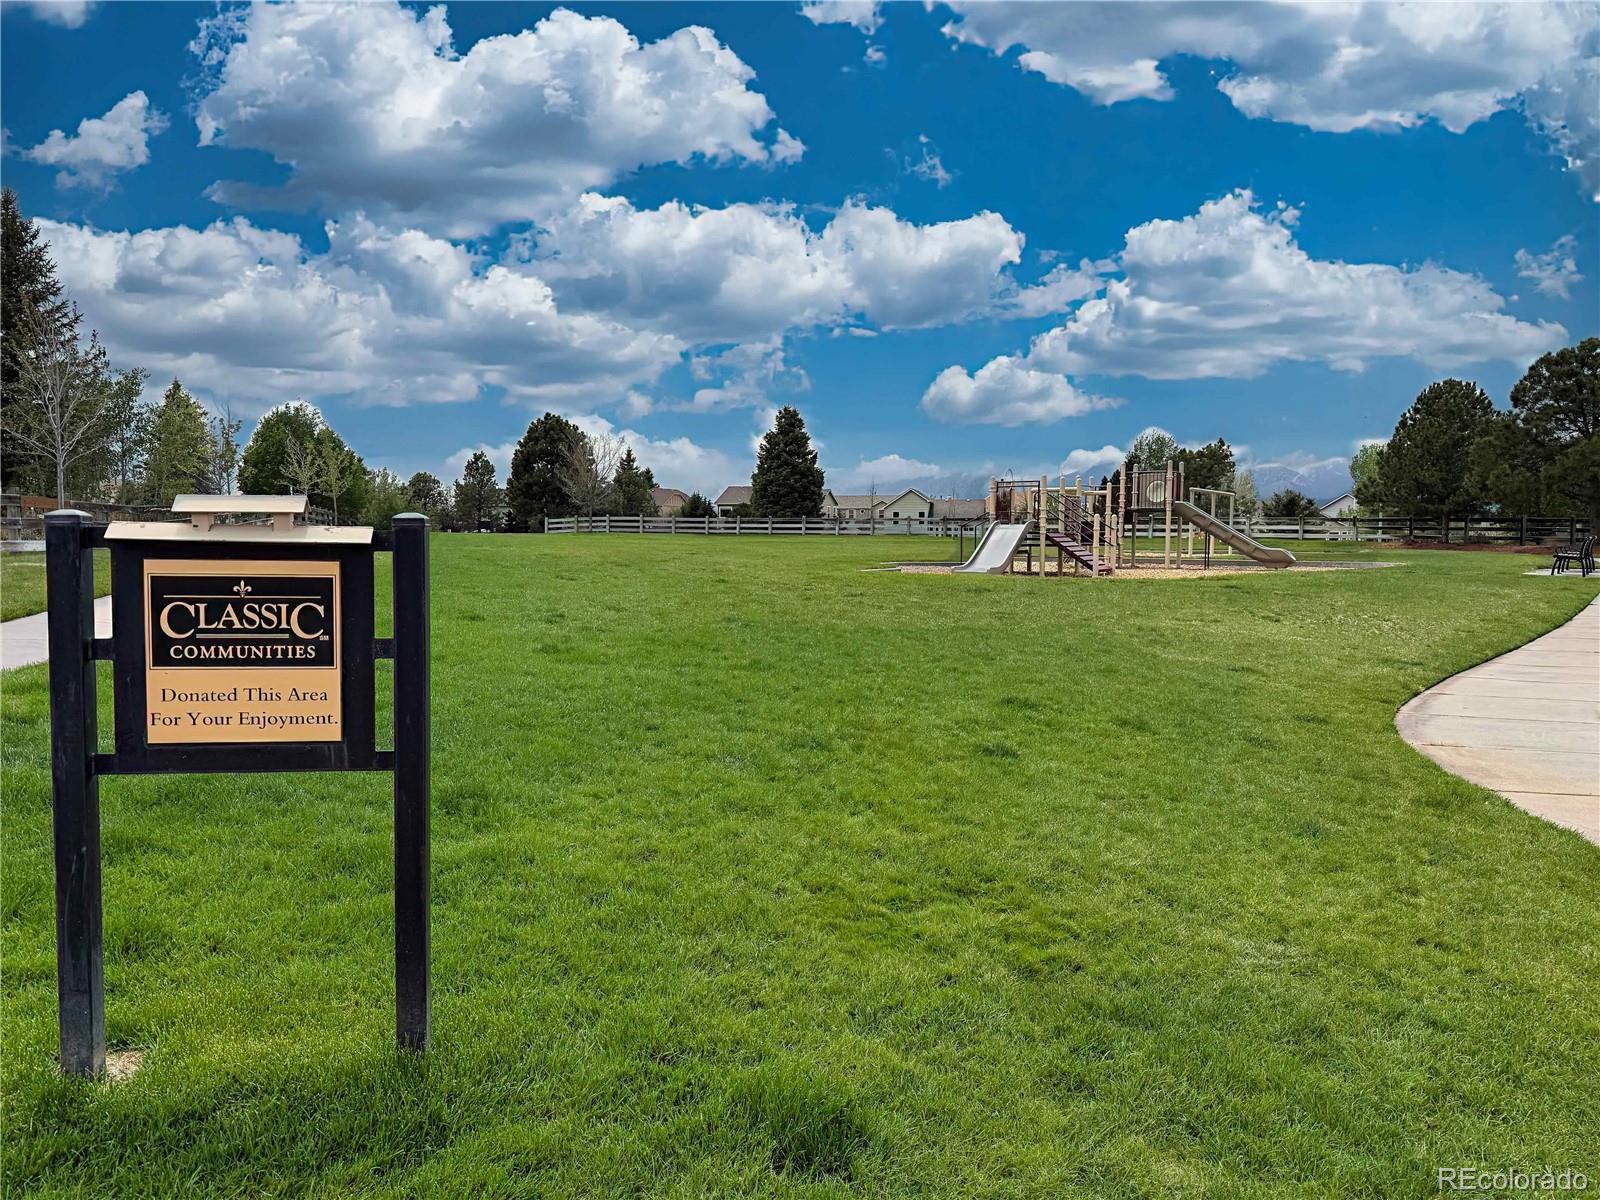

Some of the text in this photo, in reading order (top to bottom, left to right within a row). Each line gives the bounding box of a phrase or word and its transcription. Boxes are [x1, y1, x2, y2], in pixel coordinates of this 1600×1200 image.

[160, 601, 325, 640] CLASSIC
[169, 645, 316, 659] COMMUNITIES
[161, 687, 328, 702] Donated This Area
[150, 711, 339, 730] For Your Enjoyment.
